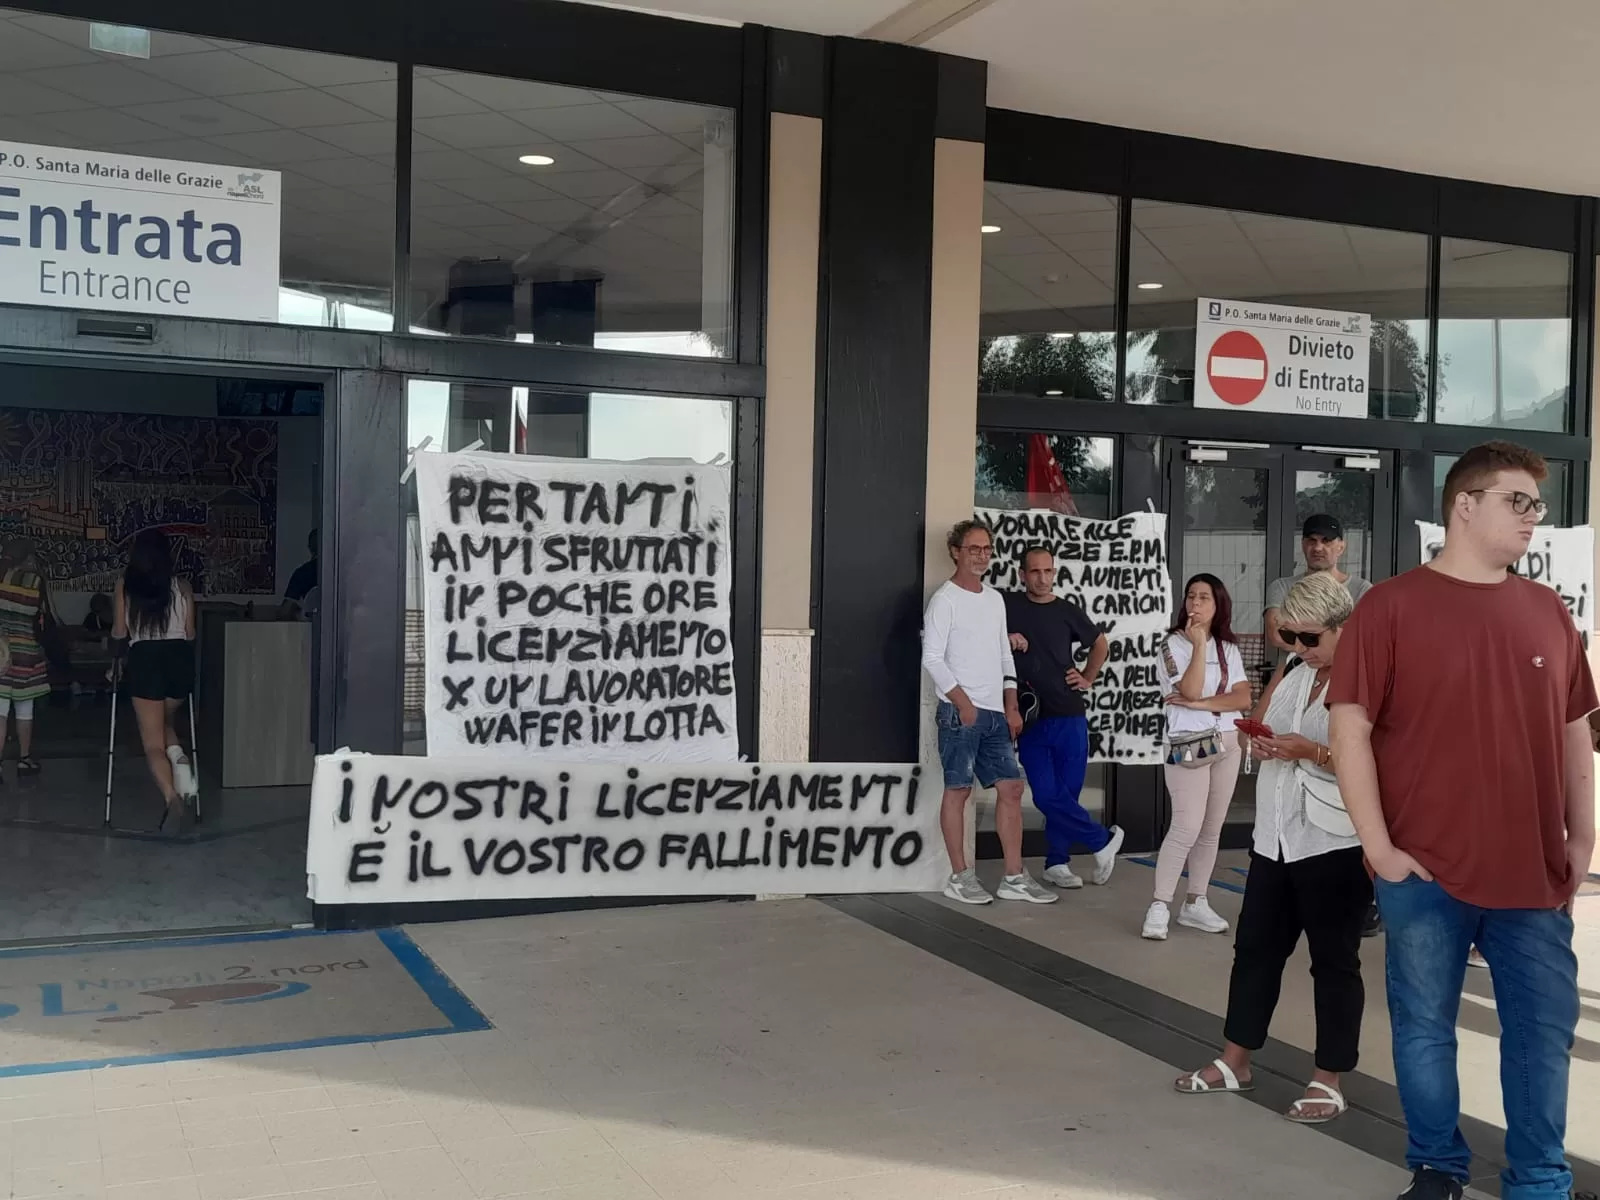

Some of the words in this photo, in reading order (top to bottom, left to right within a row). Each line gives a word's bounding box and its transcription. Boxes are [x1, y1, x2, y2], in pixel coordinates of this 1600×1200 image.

[0, 154, 29, 169] P.O.
[36, 156, 80, 174] Santa
[86, 162, 130, 180] Maria
[135, 167, 172, 184] delle
[177, 172, 223, 189] Grazie
[39, 260, 191, 304] Entrance
[1225, 308, 1242, 319] P.O.
[1244, 310, 1267, 322] Santa
[1269, 312, 1292, 324] Maria
[1294, 314, 1314, 326] delle
[1316, 317, 1341, 329] Grazie
[1289, 335, 1354, 360] Divieto
[1275, 367, 1292, 388] di
[1300, 369, 1365, 393] Entrata
[1296, 396, 1312, 410] No
[1315, 398, 1342, 415] Entry
[448, 475, 544, 525] PER
[498, 580, 634, 618] POCHE
[643, 579, 719, 614] ORE
[442, 676, 475, 711] X
[484, 673, 534, 709] UN
[538, 661, 734, 706] LAVORATORE
[463, 708, 584, 748] WAFER
[623, 703, 726, 743] LOTTA
[463, 833, 646, 877] VOSTRO
[224, 965, 260, 981] 2
[271, 958, 370, 978] nord
